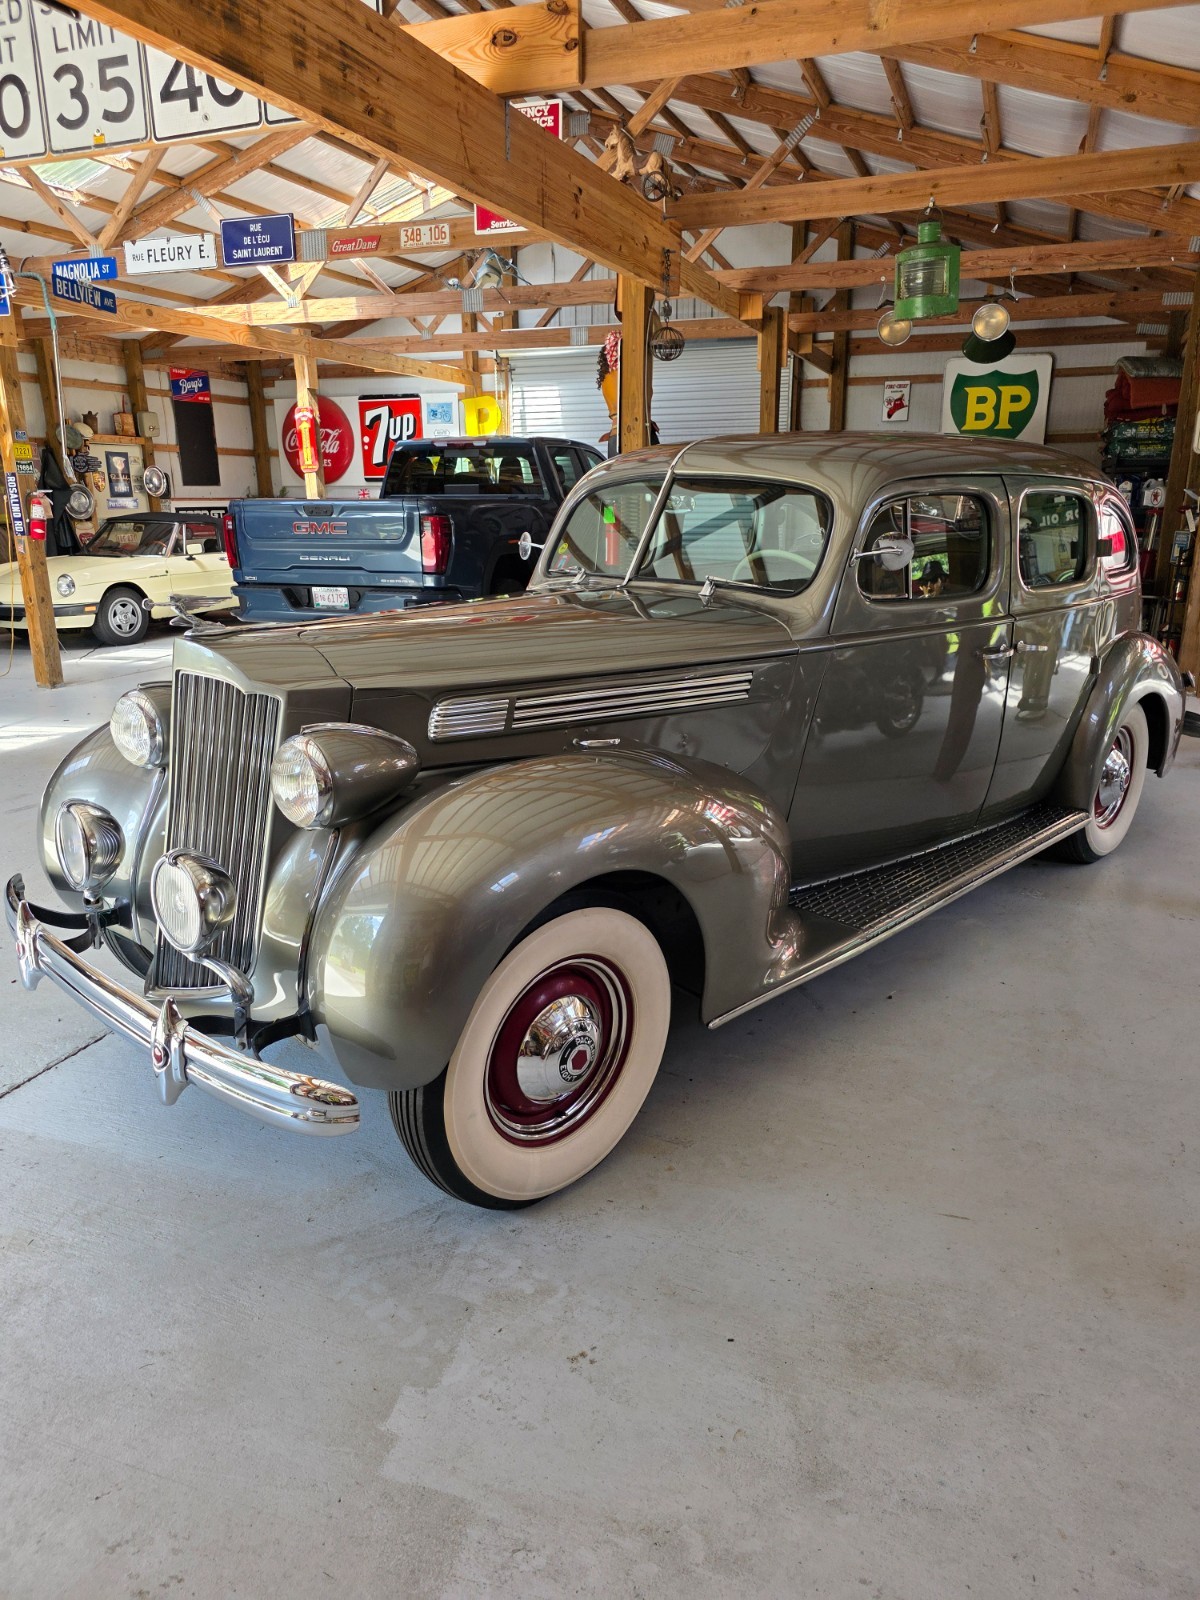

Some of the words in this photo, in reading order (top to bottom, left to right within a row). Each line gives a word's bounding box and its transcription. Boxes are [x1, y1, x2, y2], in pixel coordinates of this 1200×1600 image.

[53, 54, 135, 130] 35
[249, 223, 262, 232] RUE
[243, 236, 251, 245] DE
[252, 234, 270, 244] L'ÉCU
[132, 253, 145, 261] RUE
[147, 245, 193, 264] FLEURY
[198, 244, 210, 259] E.
[232, 249, 252, 259] SAINT
[253, 246, 283, 257] LAURENT
[55, 262, 100, 281] MAGNOLIA
[102, 264, 110, 274] ST
[56, 278, 101, 307] BELLVIEW
[103, 297, 114, 308] AVE
[961, 385, 1031, 431] BP
[7, 476, 21, 519] ROSALIND
[14, 521, 24, 535] RD
[292, 521, 348, 535] GMC
[560, 1064, 578, 1082] EIGHT
